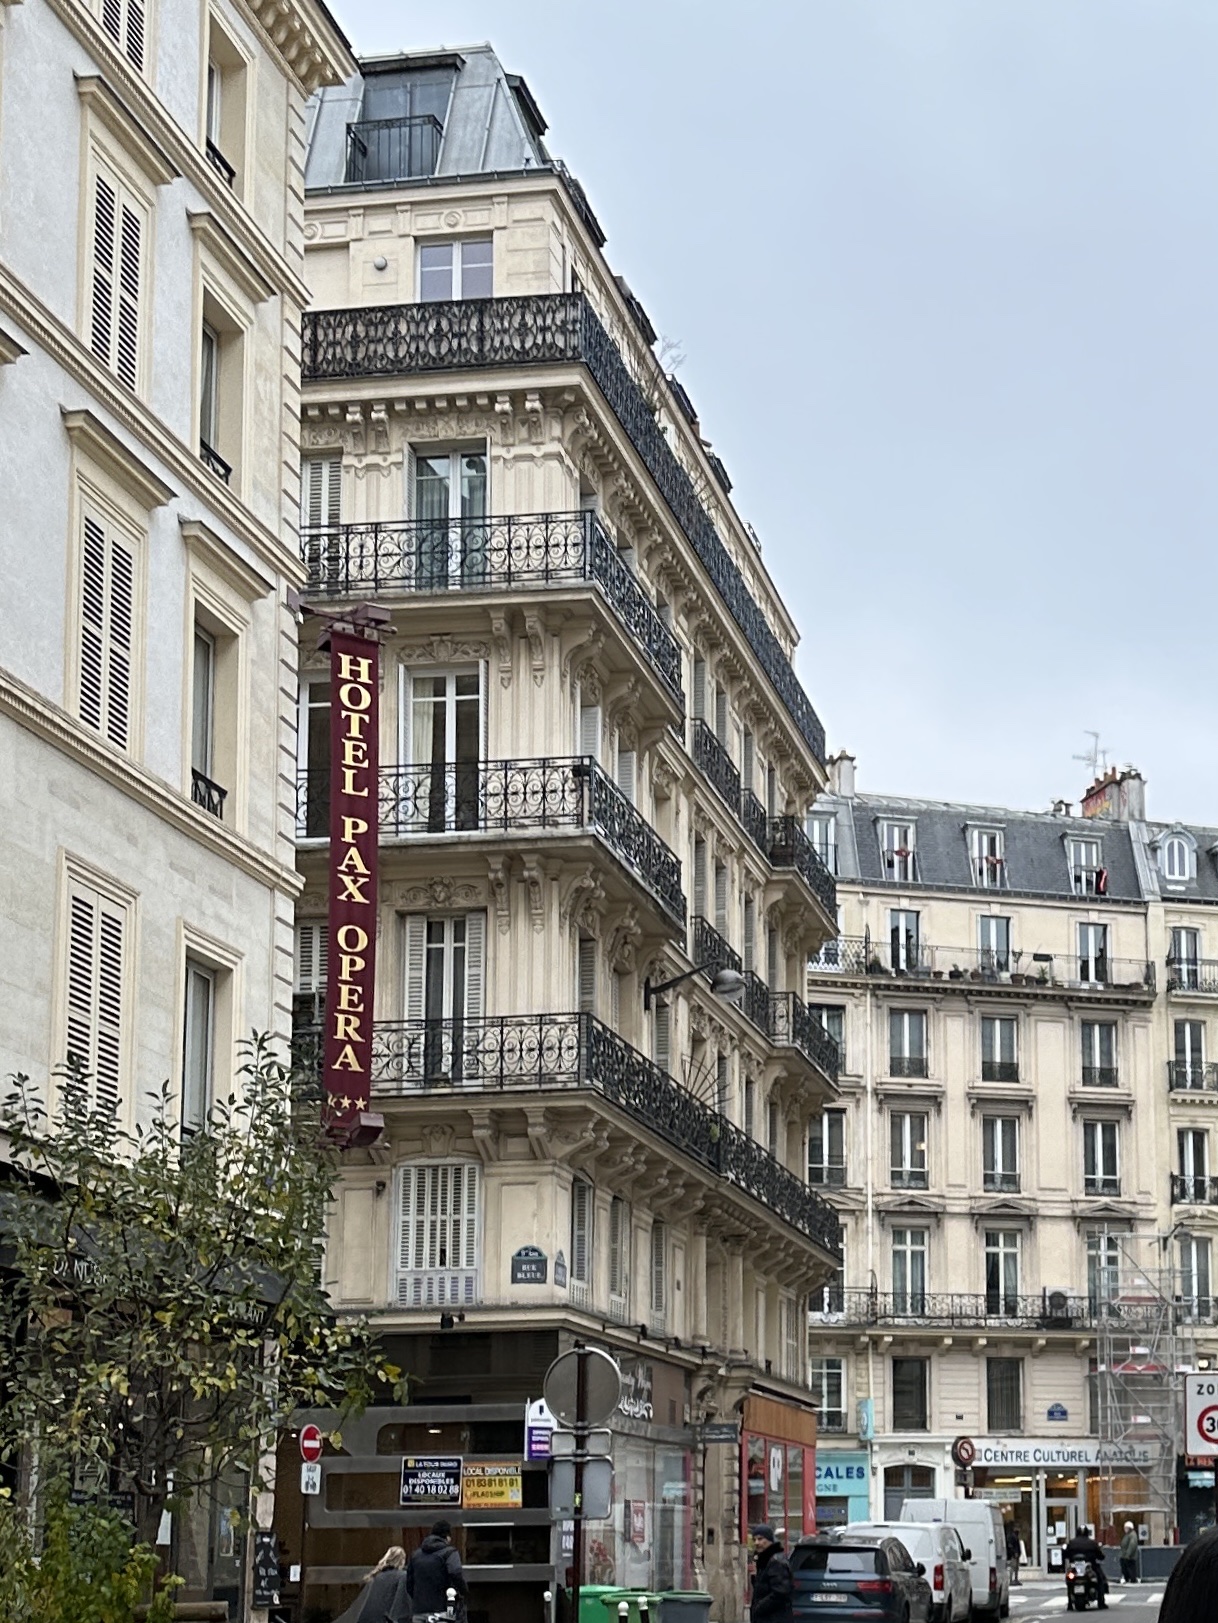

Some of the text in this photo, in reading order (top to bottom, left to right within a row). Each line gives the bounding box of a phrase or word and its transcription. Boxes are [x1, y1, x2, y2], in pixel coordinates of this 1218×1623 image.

[331, 652, 374, 1073] HOTEL PAX OPERA
[983, 1448, 1030, 1463] CENTRE
[1033, 1448, 1091, 1463] CULTUREL
[418, 1471, 445, 1479] LOCAUX
[463, 1467, 522, 1476] LOCAL DISPONIBLE
[465, 1478, 476, 1487] 01
[402, 1486, 413, 1494] 01
[415, 1486, 425, 1495] 40
[427, 1486, 437, 1495] 18
